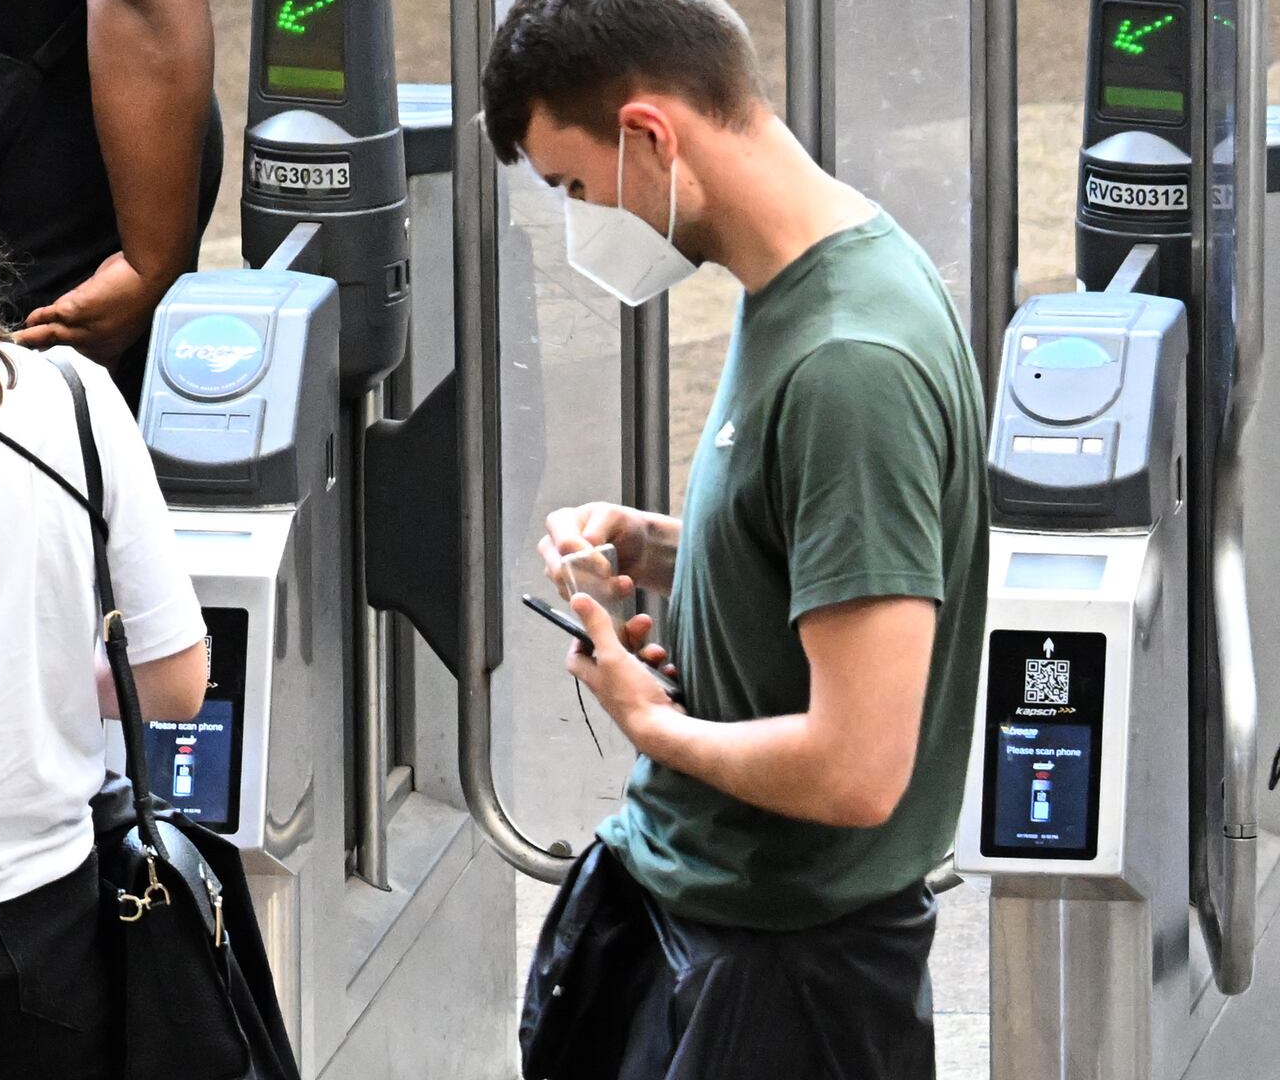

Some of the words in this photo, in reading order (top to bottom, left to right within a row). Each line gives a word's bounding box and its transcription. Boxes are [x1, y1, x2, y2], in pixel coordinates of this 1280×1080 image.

[255, 161, 348, 185] RVG30313
[1089, 180, 1184, 206] RVG30312
[1015, 707, 1057, 716] kapsch
[149, 721, 176, 729] Please
[198, 722, 224, 732] phone
[1006, 745, 1034, 754] Please
[1056, 748, 1082, 757] phone
